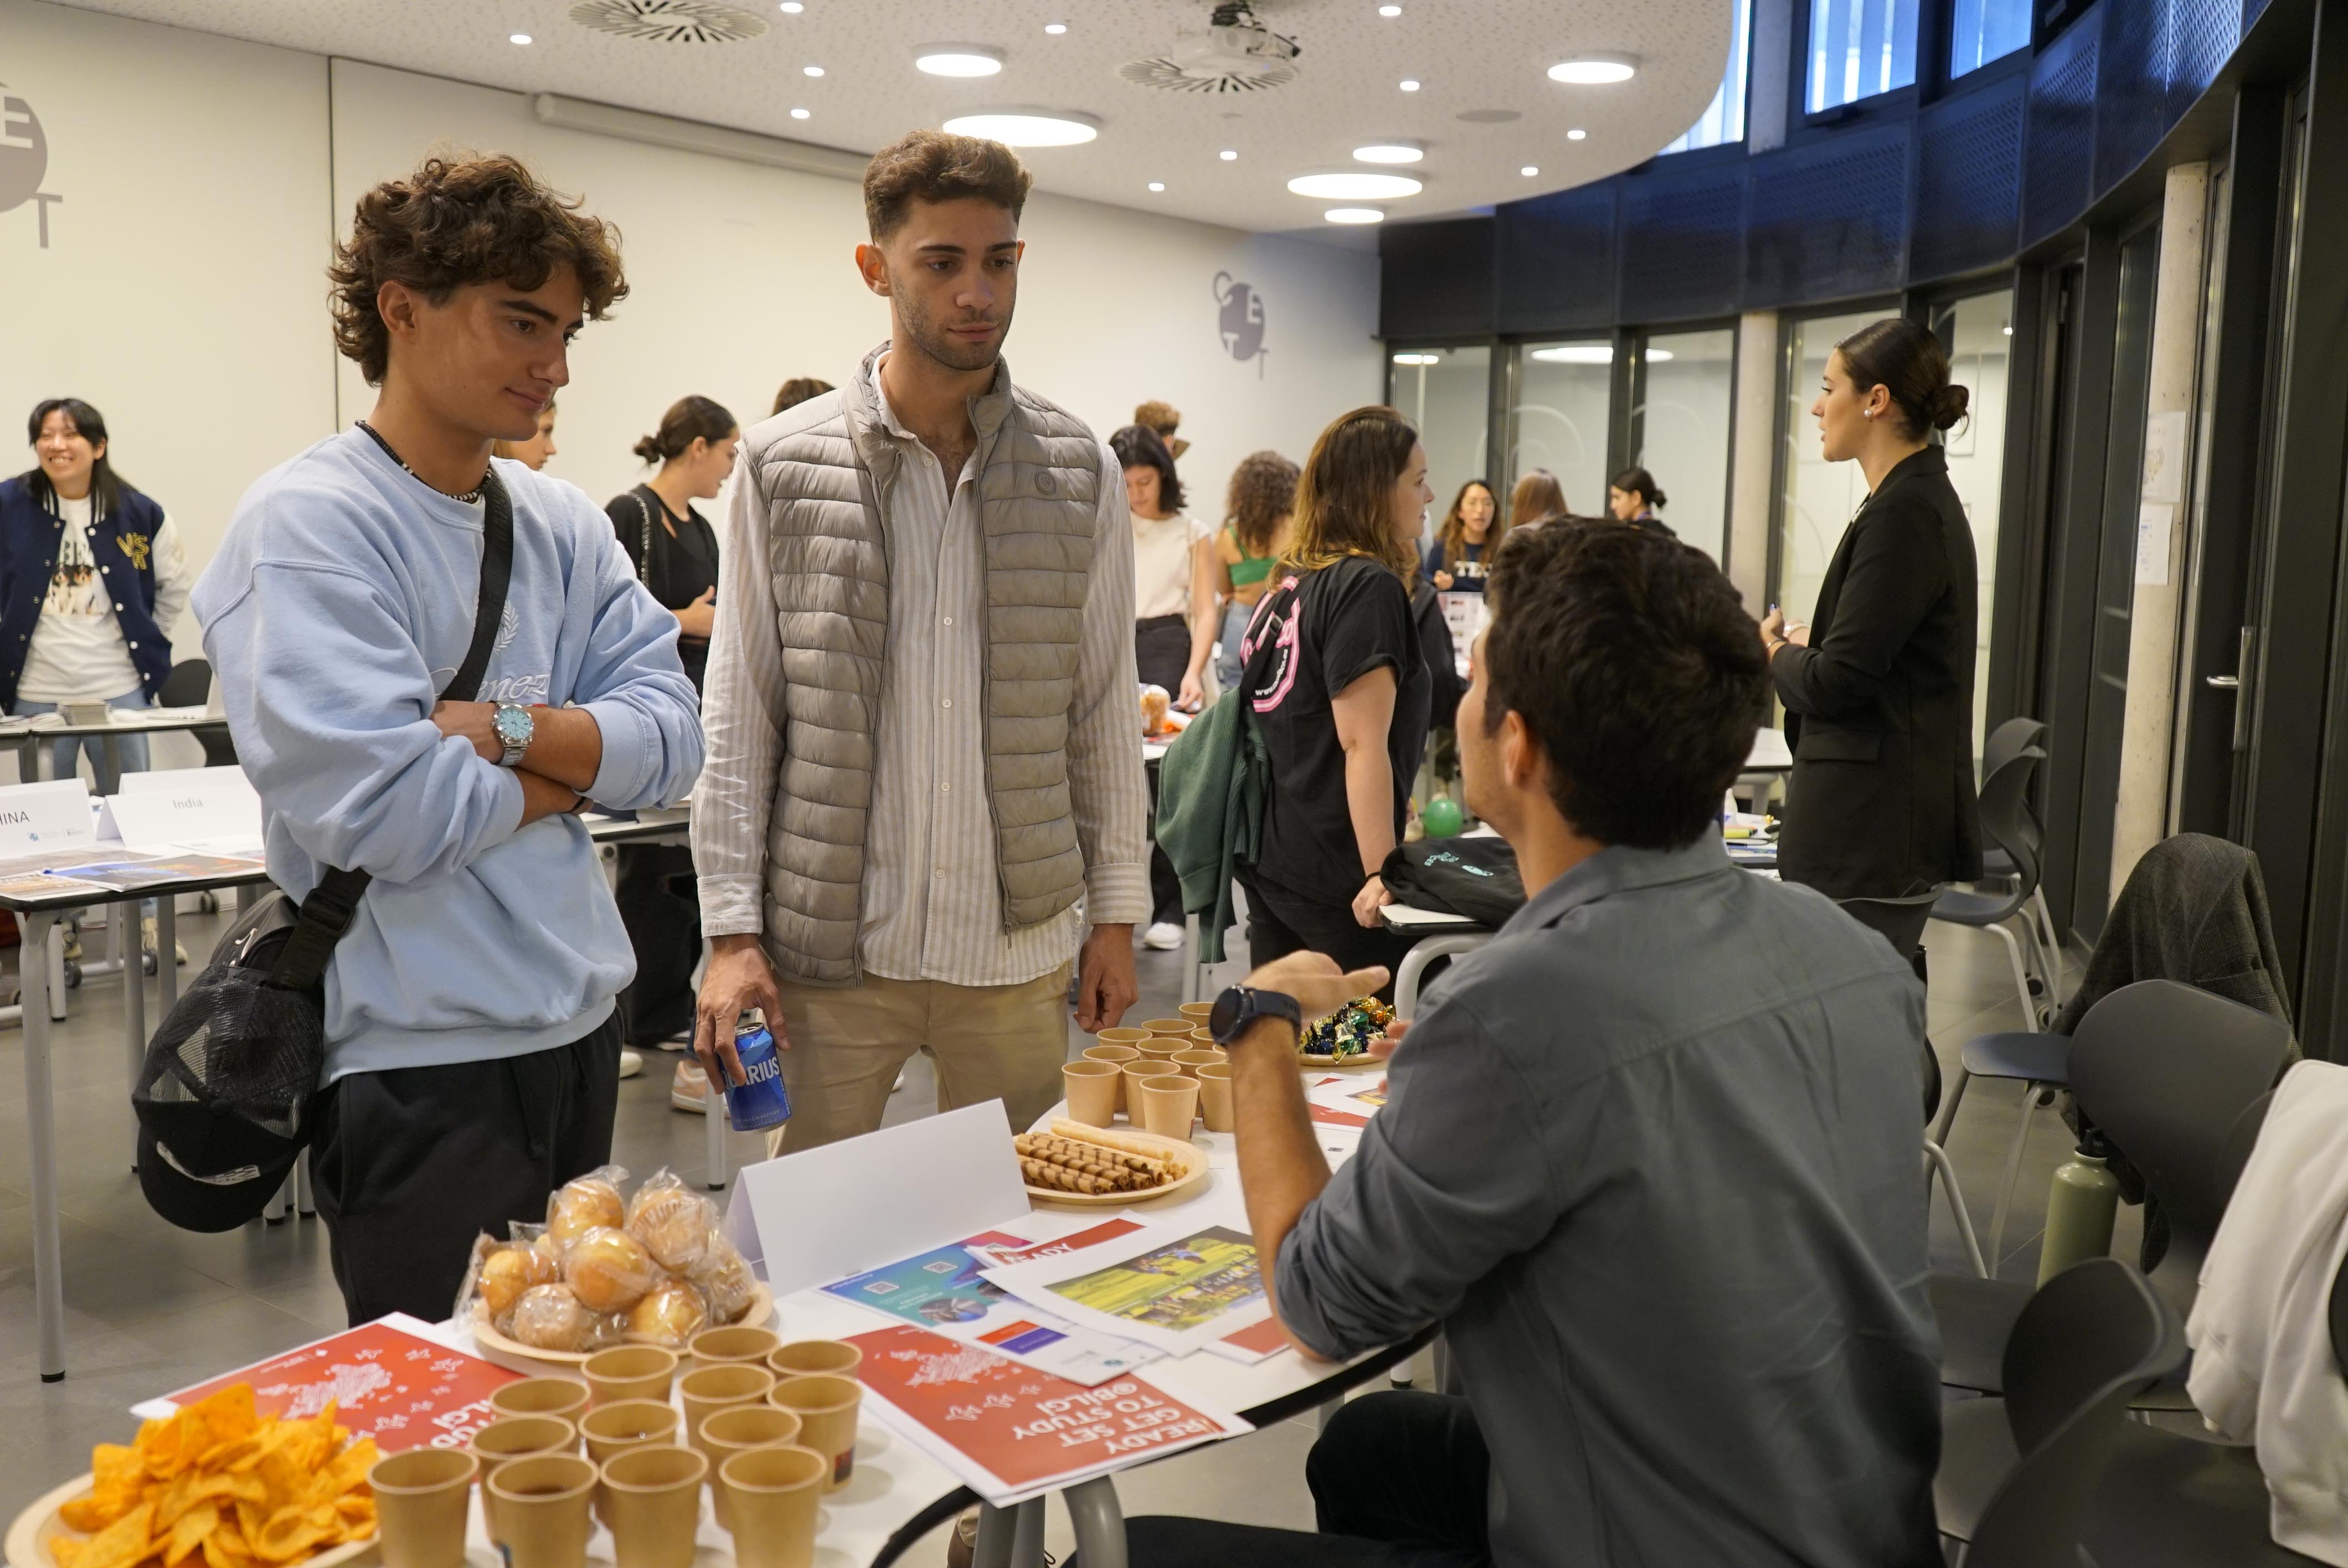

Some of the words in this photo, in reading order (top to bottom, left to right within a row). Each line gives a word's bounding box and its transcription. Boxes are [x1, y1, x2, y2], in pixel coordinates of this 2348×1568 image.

[172, 797, 203, 809] India
[1114, 1395, 1164, 1412] TO
[1012, 1406, 1113, 1441] STUDY
[1122, 1407, 1182, 1432] GET
[1059, 1423, 1116, 1448] SET
[1105, 1417, 1206, 1454] READY
